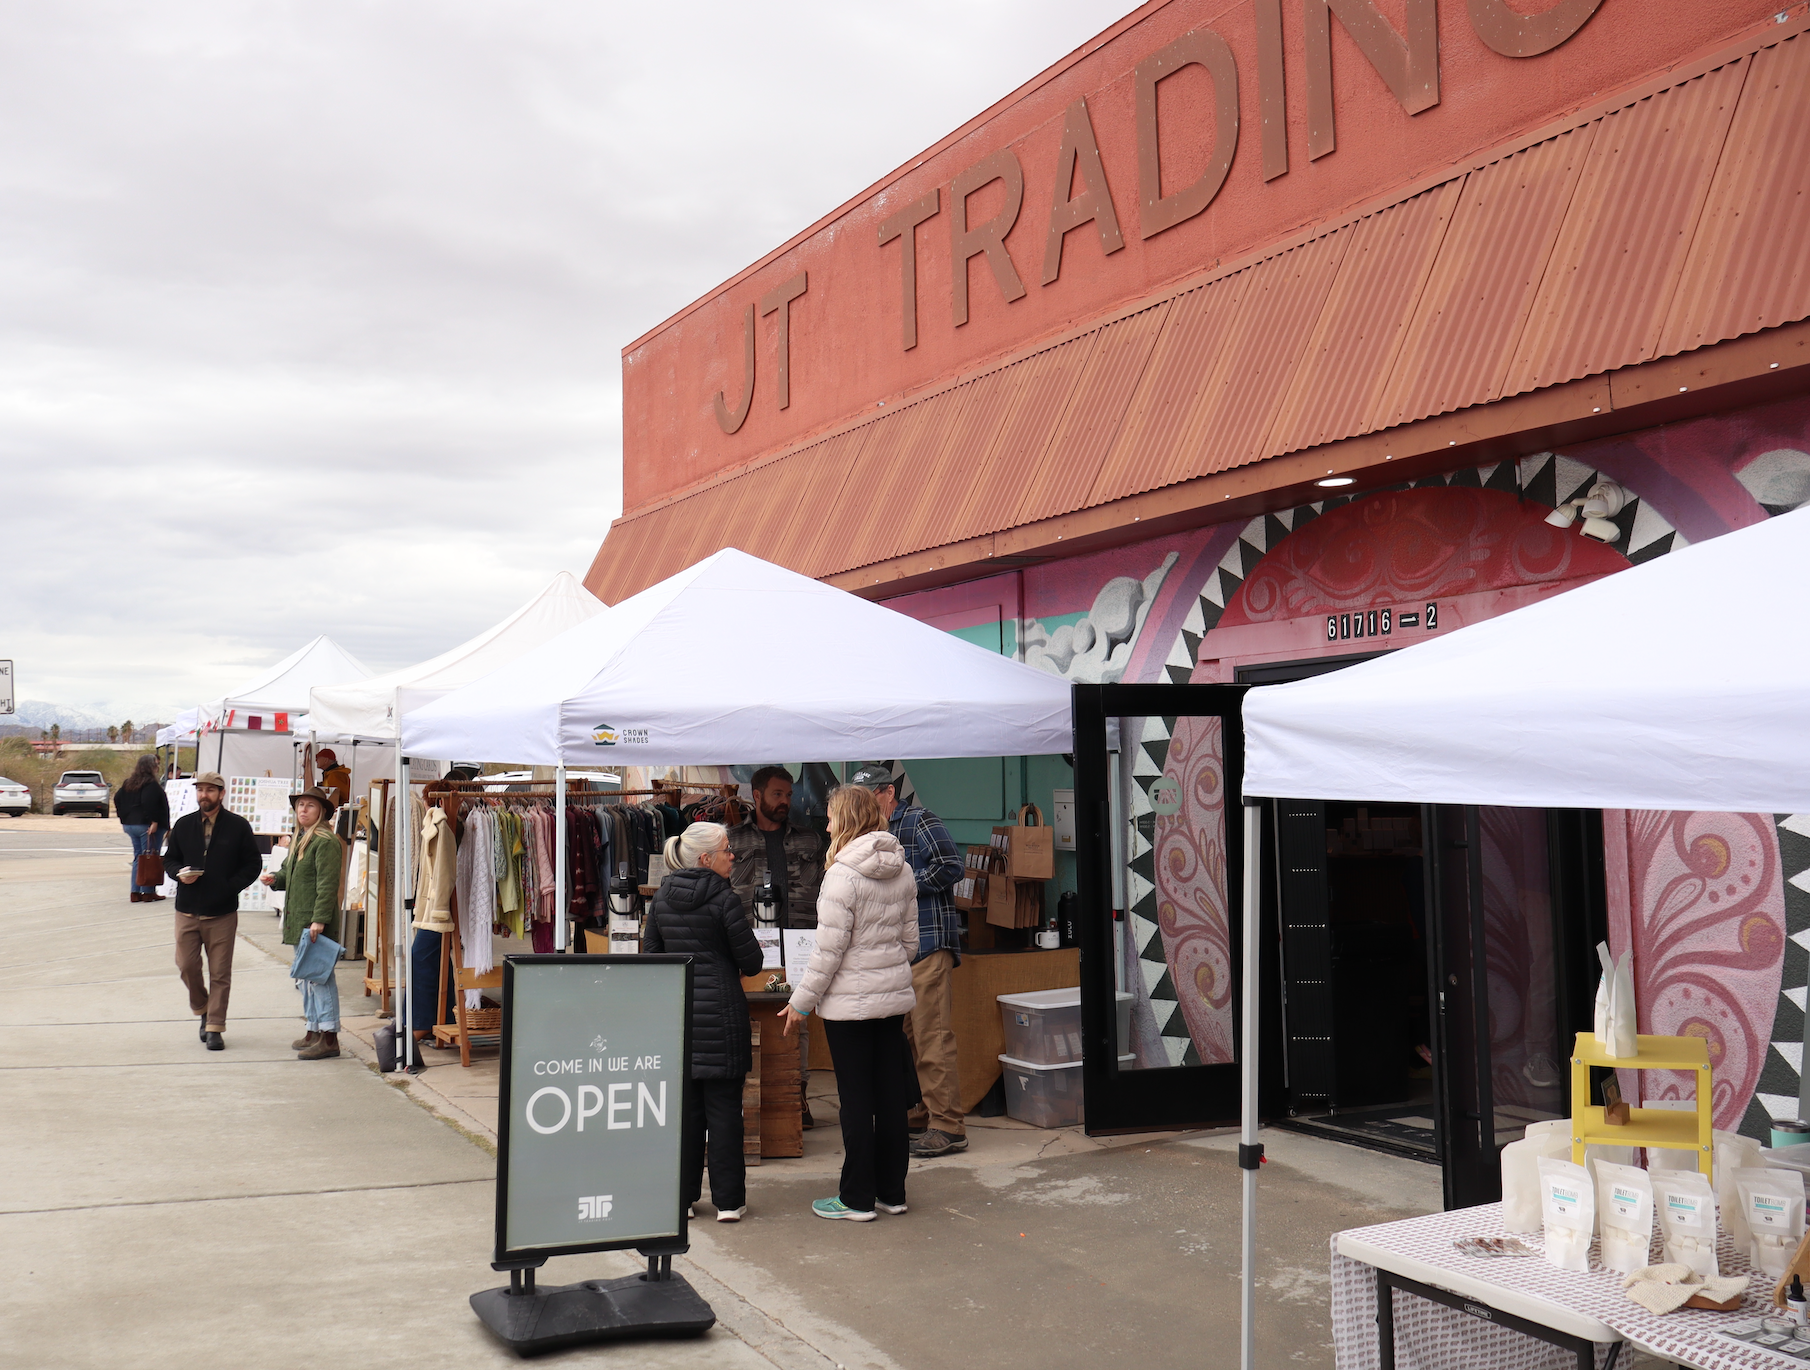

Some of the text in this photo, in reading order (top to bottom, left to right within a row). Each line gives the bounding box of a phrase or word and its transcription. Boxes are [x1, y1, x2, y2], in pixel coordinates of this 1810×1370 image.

[713, 0, 1606, 435] JT TRADIN
[622, 729, 649, 737] CROWN
[533, 1055, 662, 1076] COME IN WE ARE
[526, 1080, 667, 1135] OPEN
